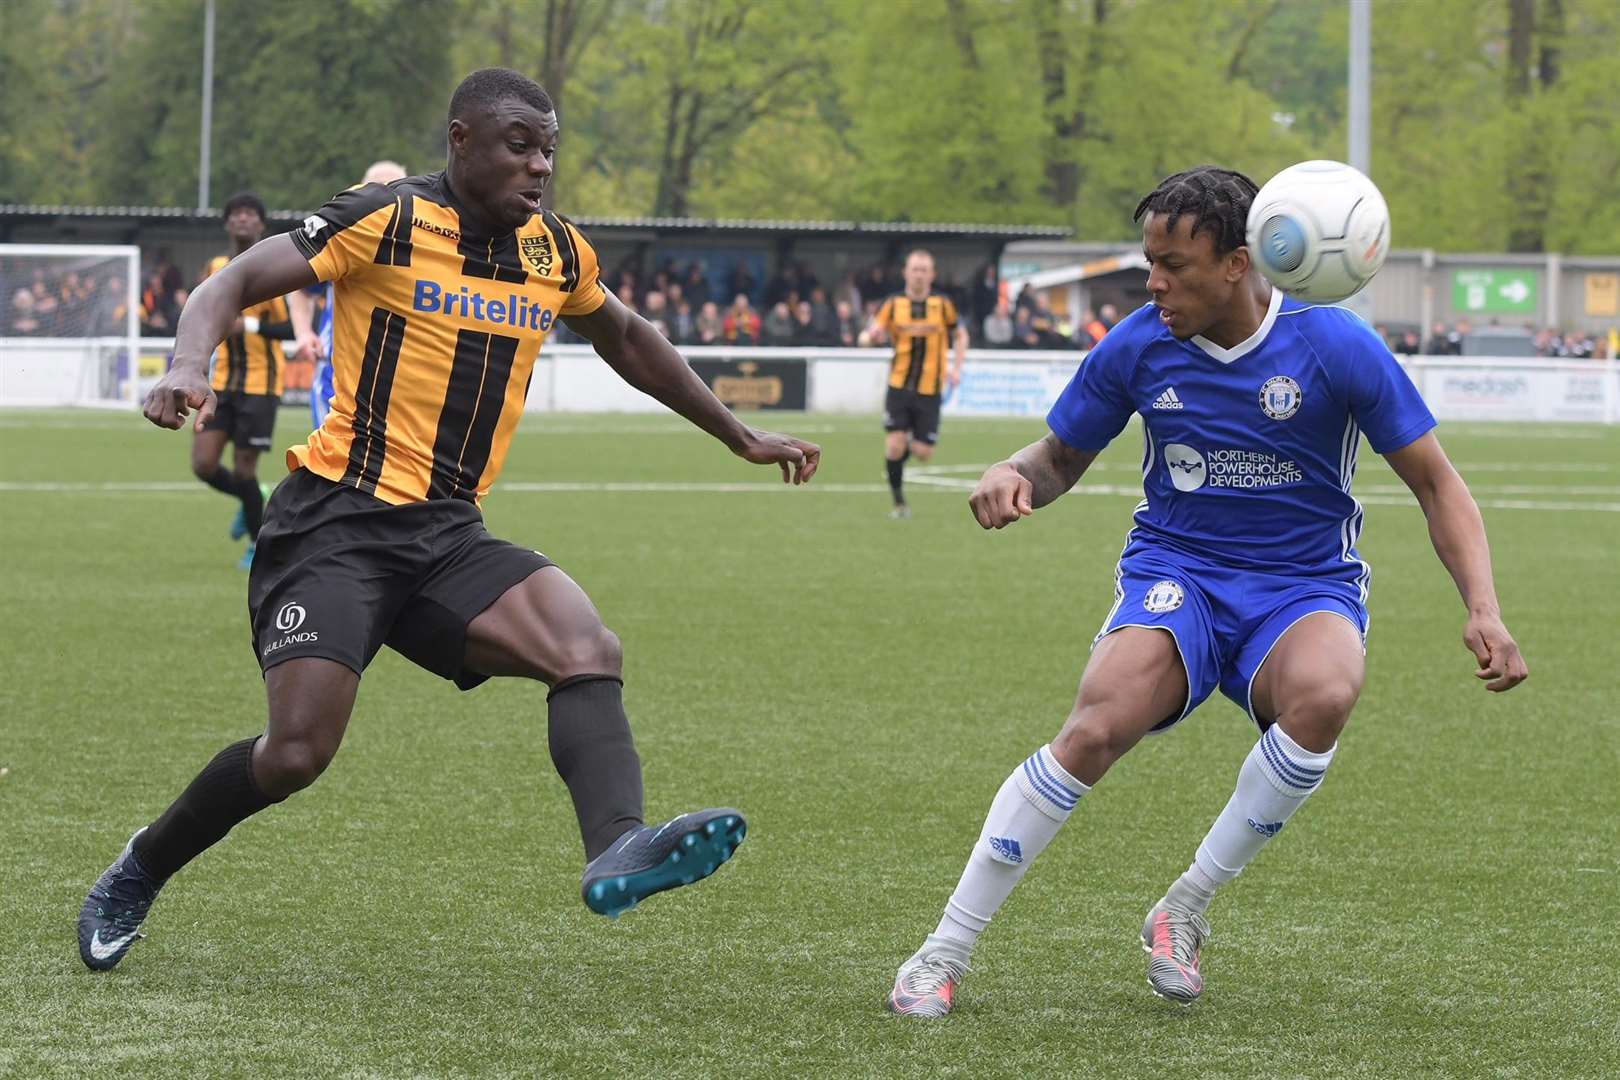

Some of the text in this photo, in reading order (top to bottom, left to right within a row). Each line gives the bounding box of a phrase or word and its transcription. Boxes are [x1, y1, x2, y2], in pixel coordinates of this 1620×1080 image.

[413, 279, 553, 332] Britelite
[1152, 400, 1184, 410] adidas
[1207, 450, 1276, 463] NORTHERN
[1208, 460, 1295, 475] POWERHOUSE
[1209, 469, 1302, 488] DEVELOPMENTS
